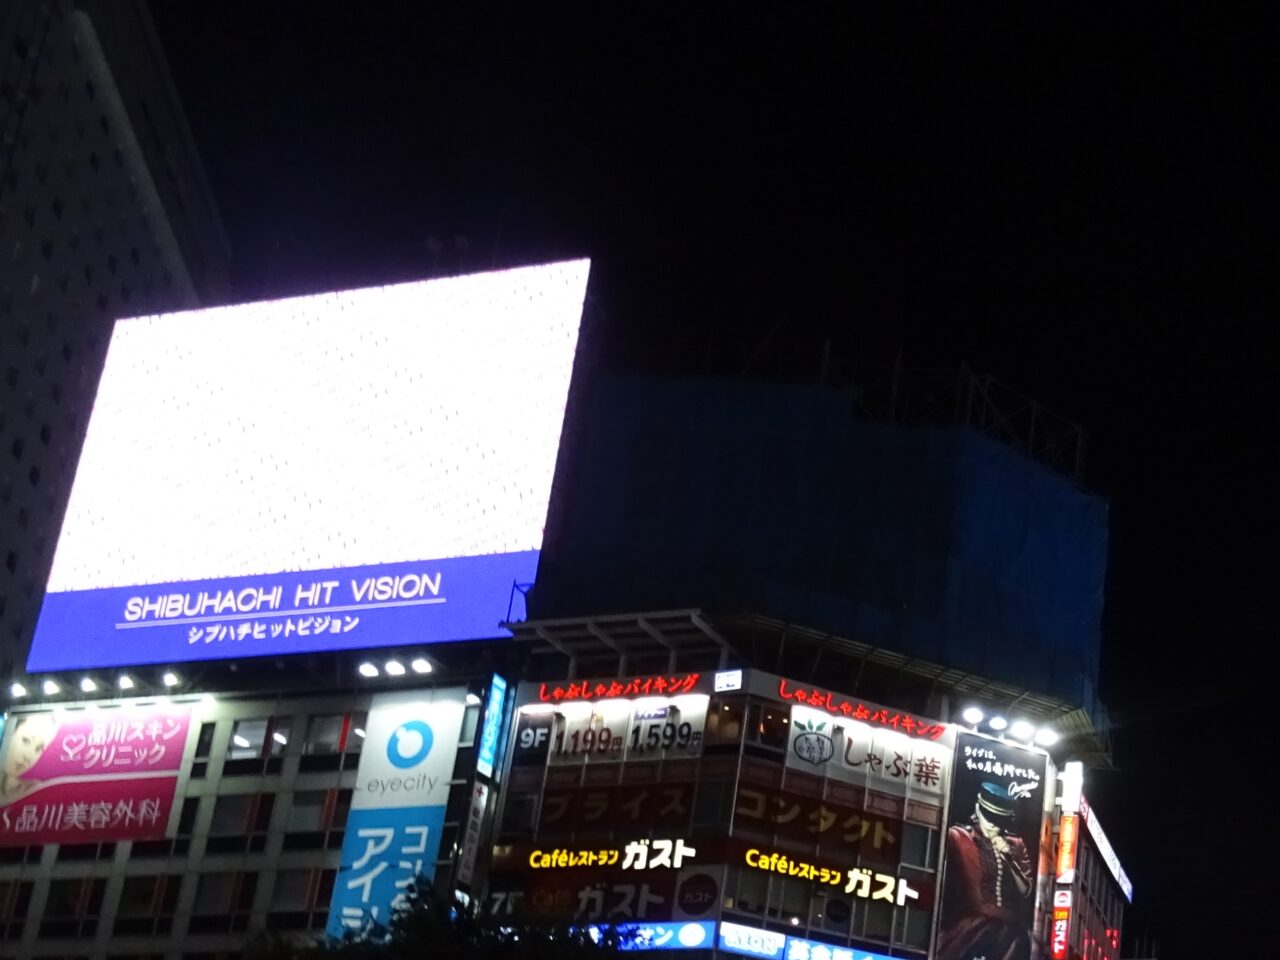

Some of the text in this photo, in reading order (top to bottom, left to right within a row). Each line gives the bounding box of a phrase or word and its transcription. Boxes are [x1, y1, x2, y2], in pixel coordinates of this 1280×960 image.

[125, 572, 441, 622] SHIBUHACHI HIT VISION
[188, 615, 360, 645] シブハチヒットビジョン
[539, 673, 699, 701] しゃぶしゃぶバイキング
[779, 678, 946, 740] しゃぶしゃぶバイキング
[520, 728, 548, 749] 9F
[83, 742, 166, 769] クリニック
[844, 736, 940, 786] しゃぶ葉
[367, 773, 438, 797] eyecity
[15, 797, 161, 833] 品川美容外科
[621, 838, 696, 870] ガスト
[845, 866, 919, 907] ガスト
